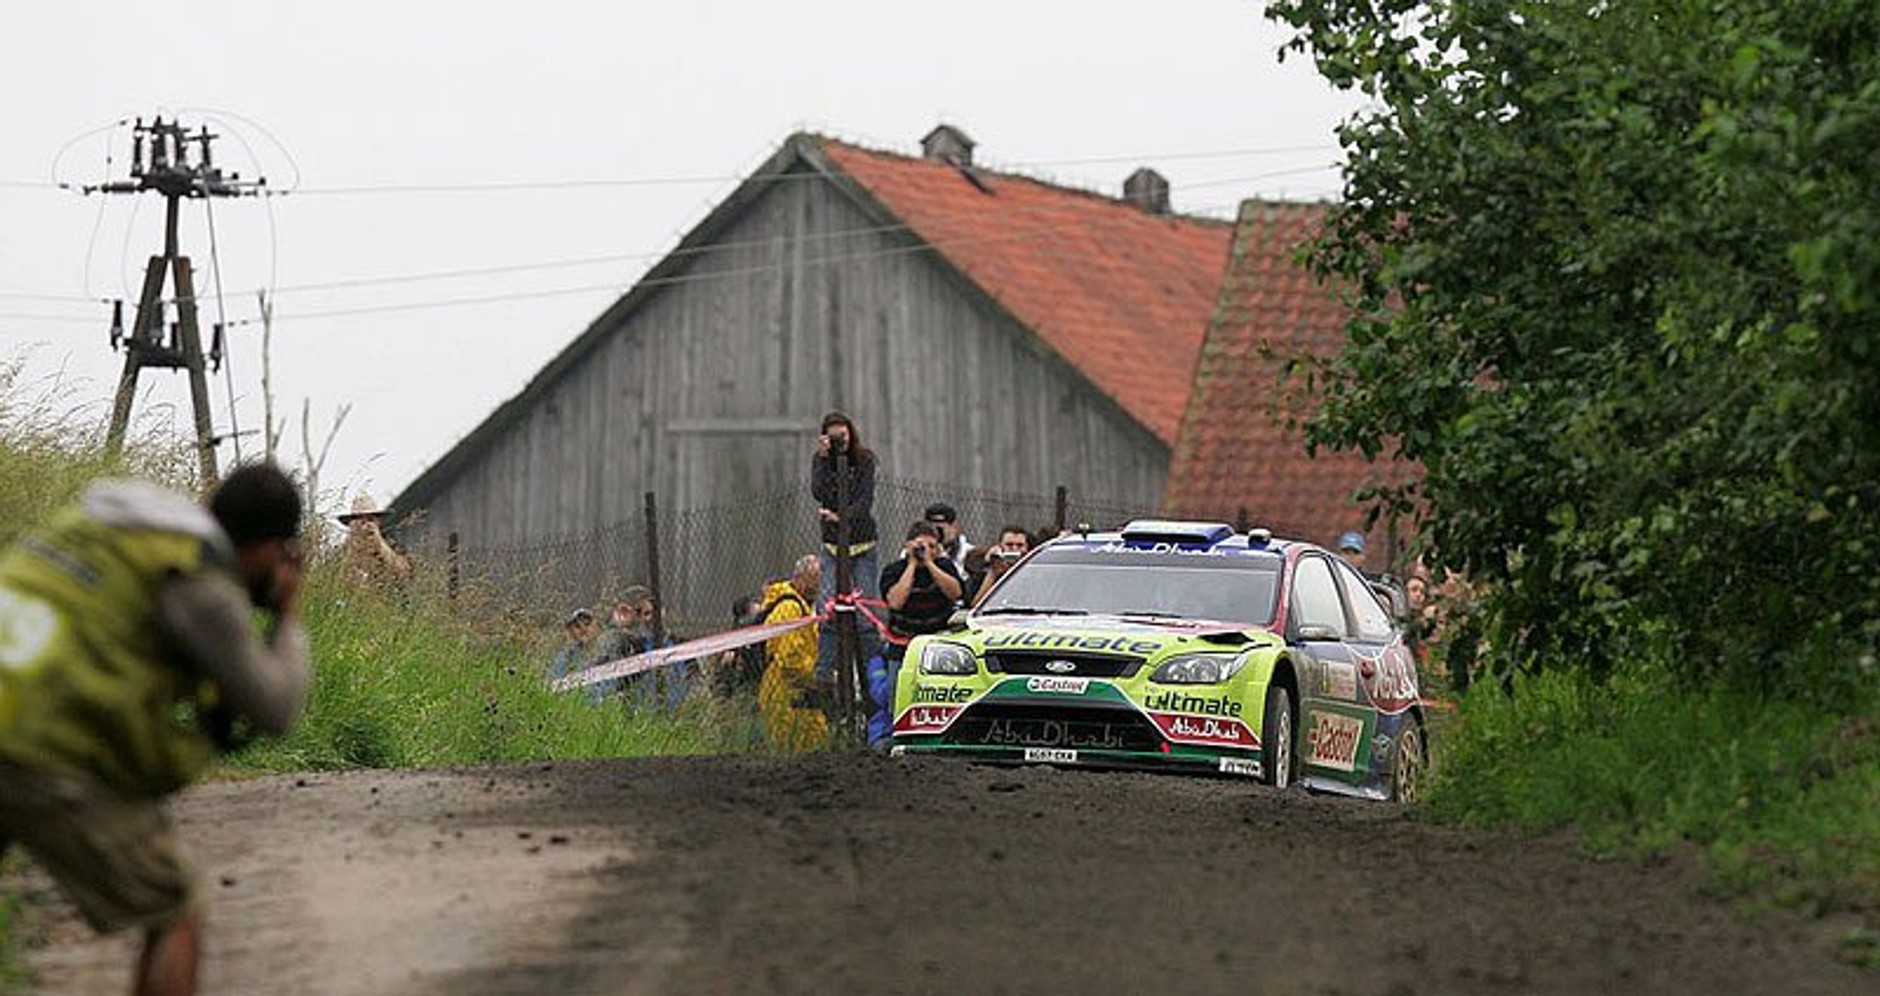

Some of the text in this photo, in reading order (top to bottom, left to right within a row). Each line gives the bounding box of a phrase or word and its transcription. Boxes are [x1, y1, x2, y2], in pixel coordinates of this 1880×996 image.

[983, 632, 1162, 653] ultimate
[1040, 679, 1084, 694] Castrol
[1145, 691, 1242, 717] ultimate
